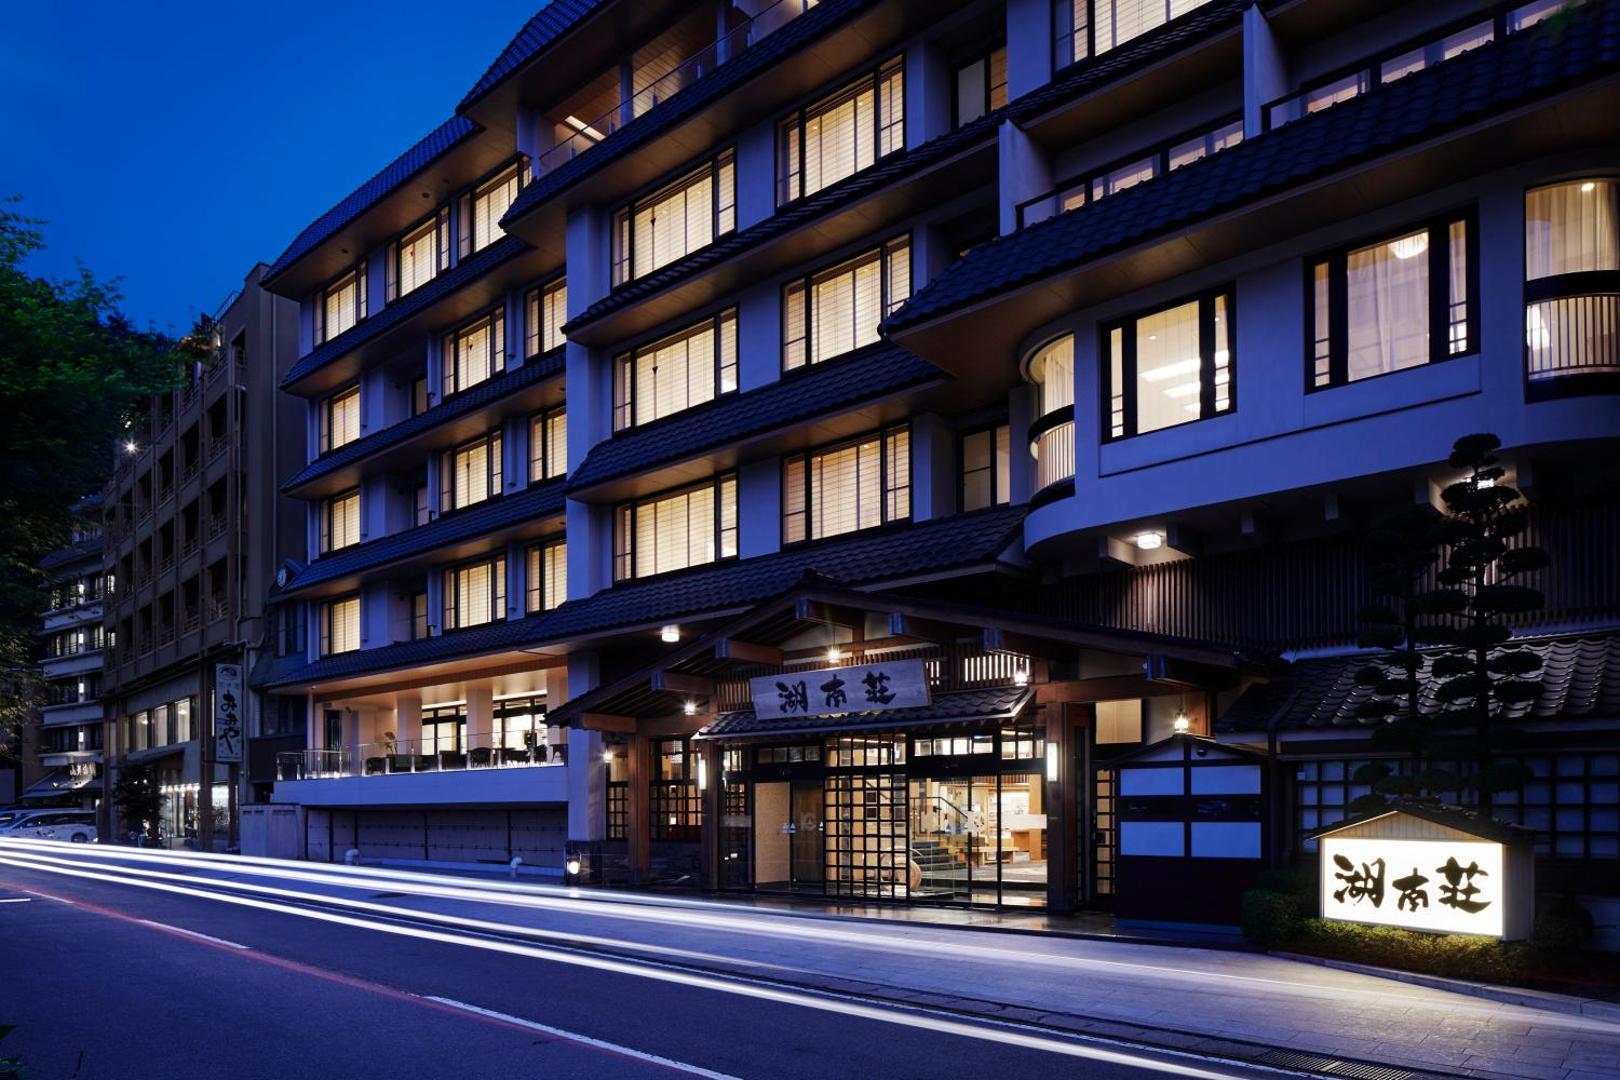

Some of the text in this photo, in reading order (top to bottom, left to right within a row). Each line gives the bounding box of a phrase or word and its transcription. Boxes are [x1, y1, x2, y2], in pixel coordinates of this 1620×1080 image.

[775, 671, 896, 713] 湖南荘
[1333, 853, 1493, 914] 湖南荘
